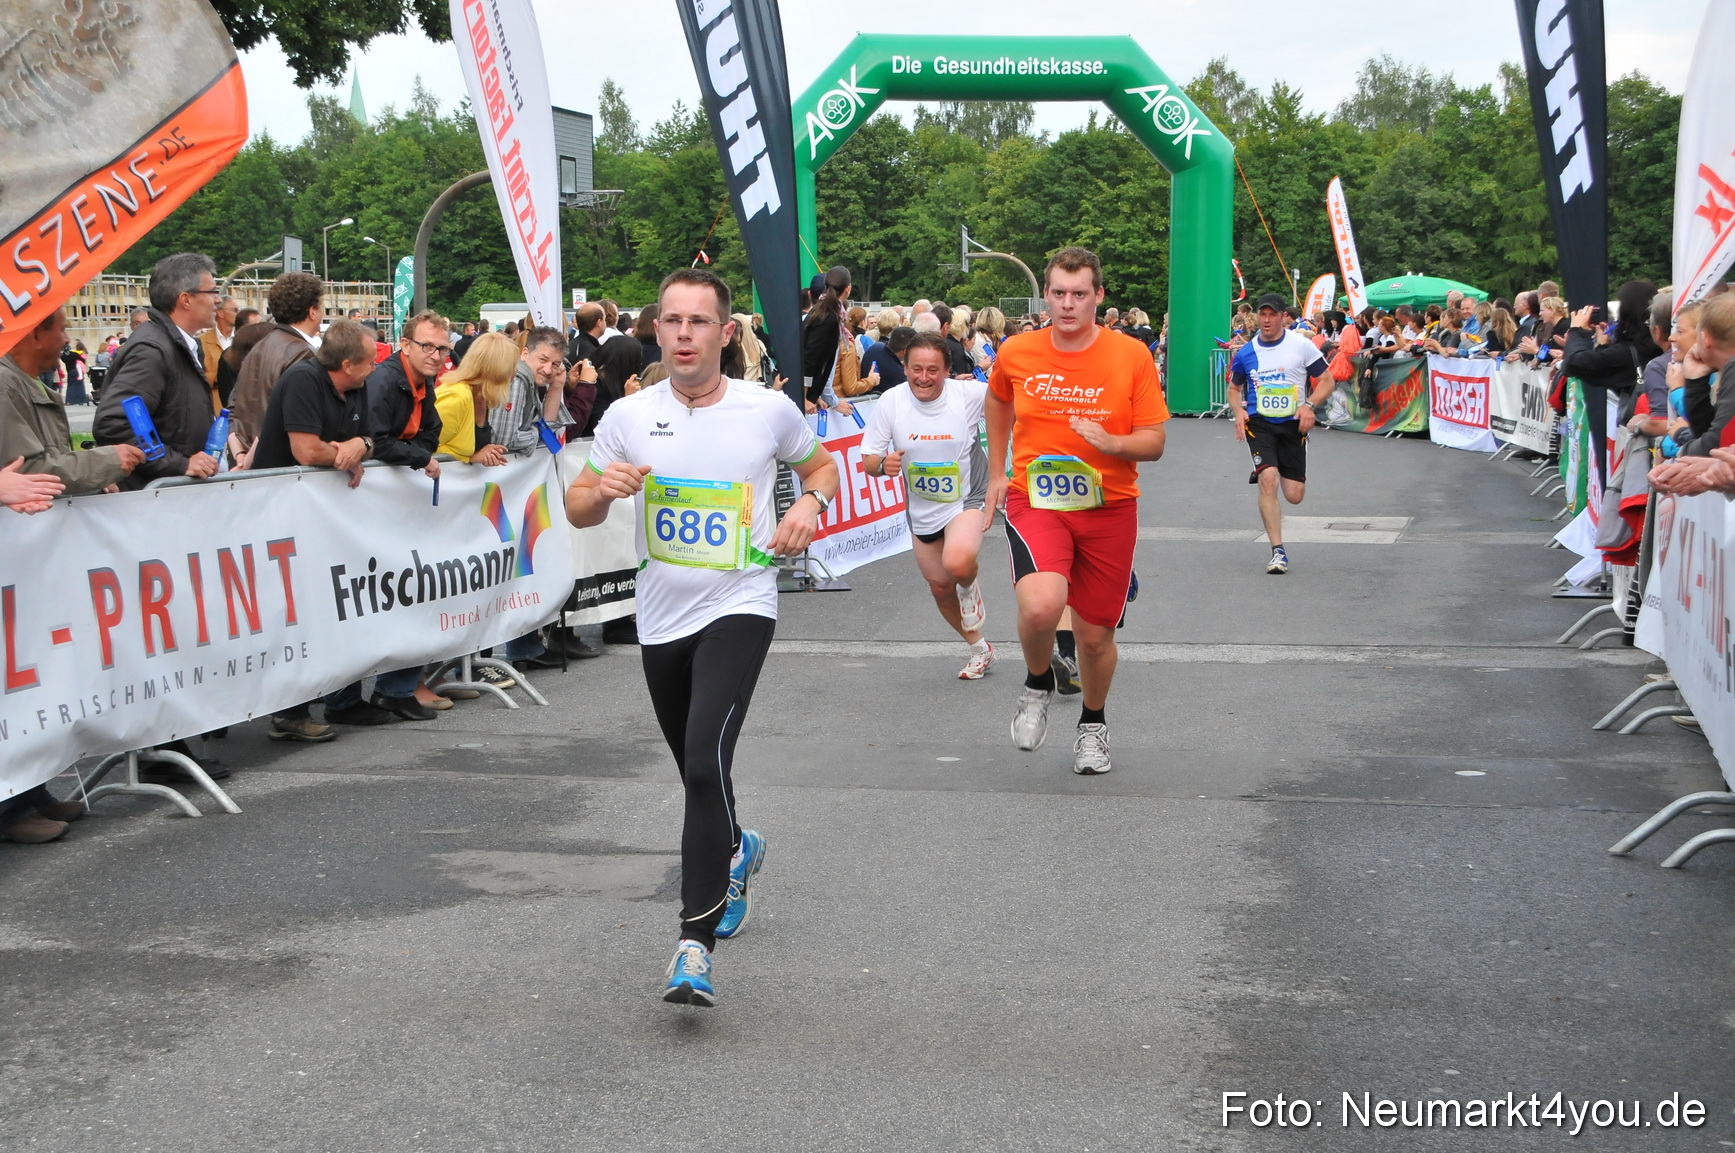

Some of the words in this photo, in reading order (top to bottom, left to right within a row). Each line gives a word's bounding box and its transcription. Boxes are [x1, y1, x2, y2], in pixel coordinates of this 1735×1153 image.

[891, 55, 922, 74] Die
[933, 56, 1108, 76] Gesundheitskasse.
[805, 63, 881, 161] AOK
[1123, 84, 1212, 160] AOK
[1035, 375, 1104, 398] Fischer
[1040, 395, 1098, 404] AUTOMOBILE
[1261, 396, 1289, 408] 669
[1433, 375, 1486, 425] MEIER
[915, 477, 953, 493] 493
[1036, 475, 1088, 497] 996
[655, 508, 728, 547] 686
[668, 544, 694, 554] Martin
[331, 546, 515, 622] Frischmann
[577, 586, 601, 602] Leistung,
[602, 581, 616, 595] die
[617, 578, 636, 592] verb
[440, 605, 480, 631] Druck
[494, 590, 540, 617] Medien
